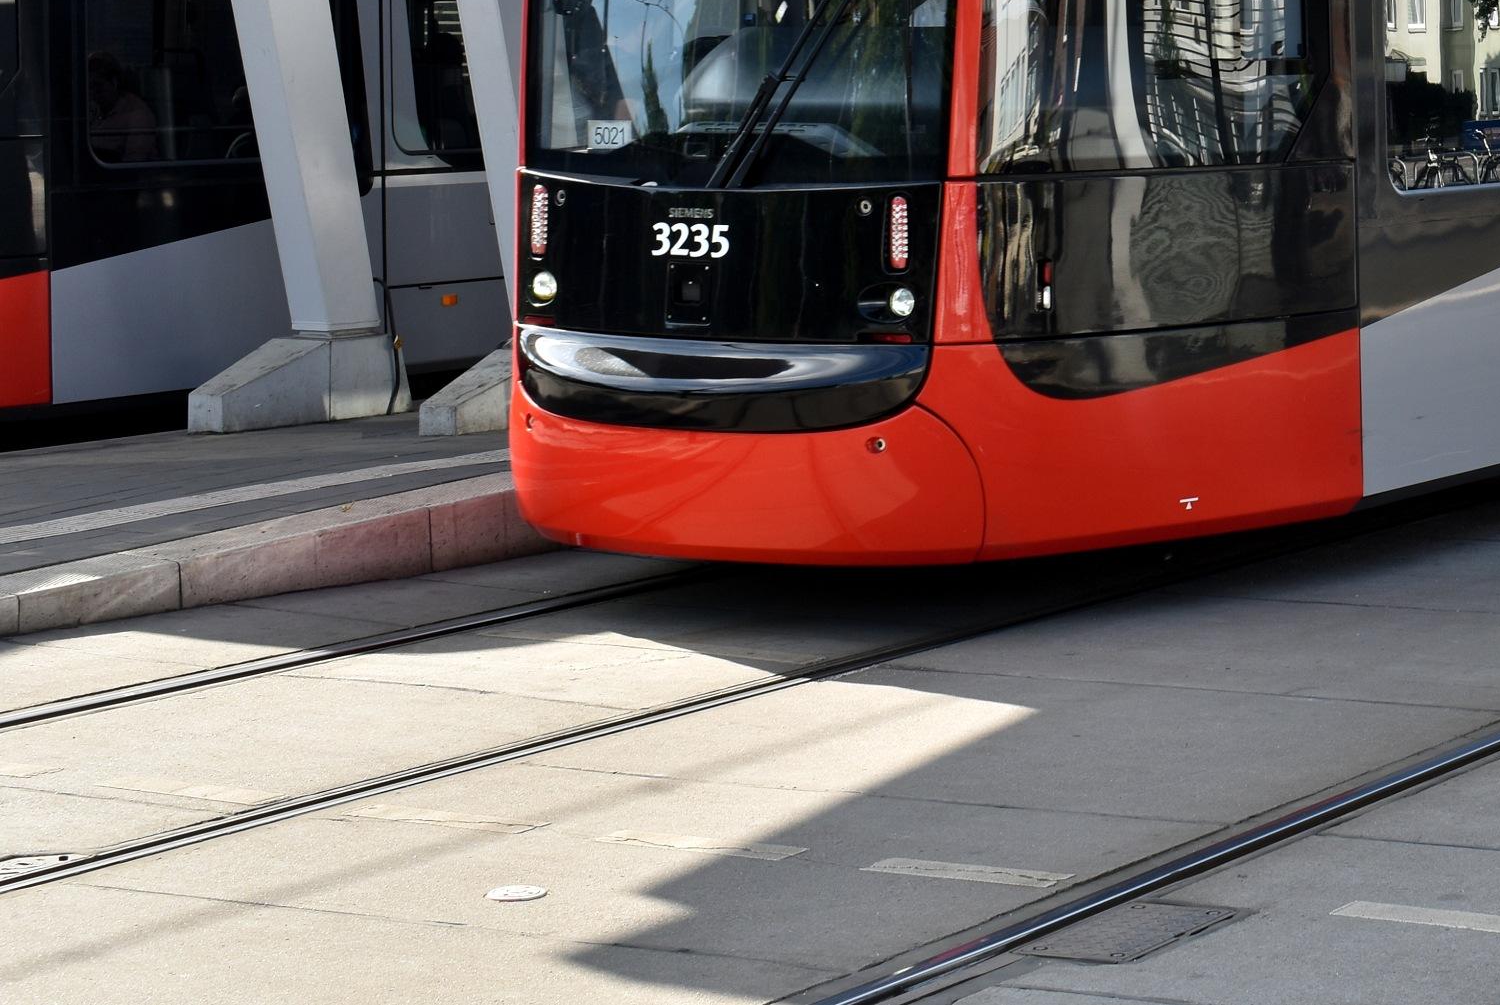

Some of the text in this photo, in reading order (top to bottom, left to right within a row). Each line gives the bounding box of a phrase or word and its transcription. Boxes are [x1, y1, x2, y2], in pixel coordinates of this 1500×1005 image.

[595, 126, 625, 145] 5021
[668, 207, 714, 219] SIEMENS
[651, 222, 730, 258] 3235
